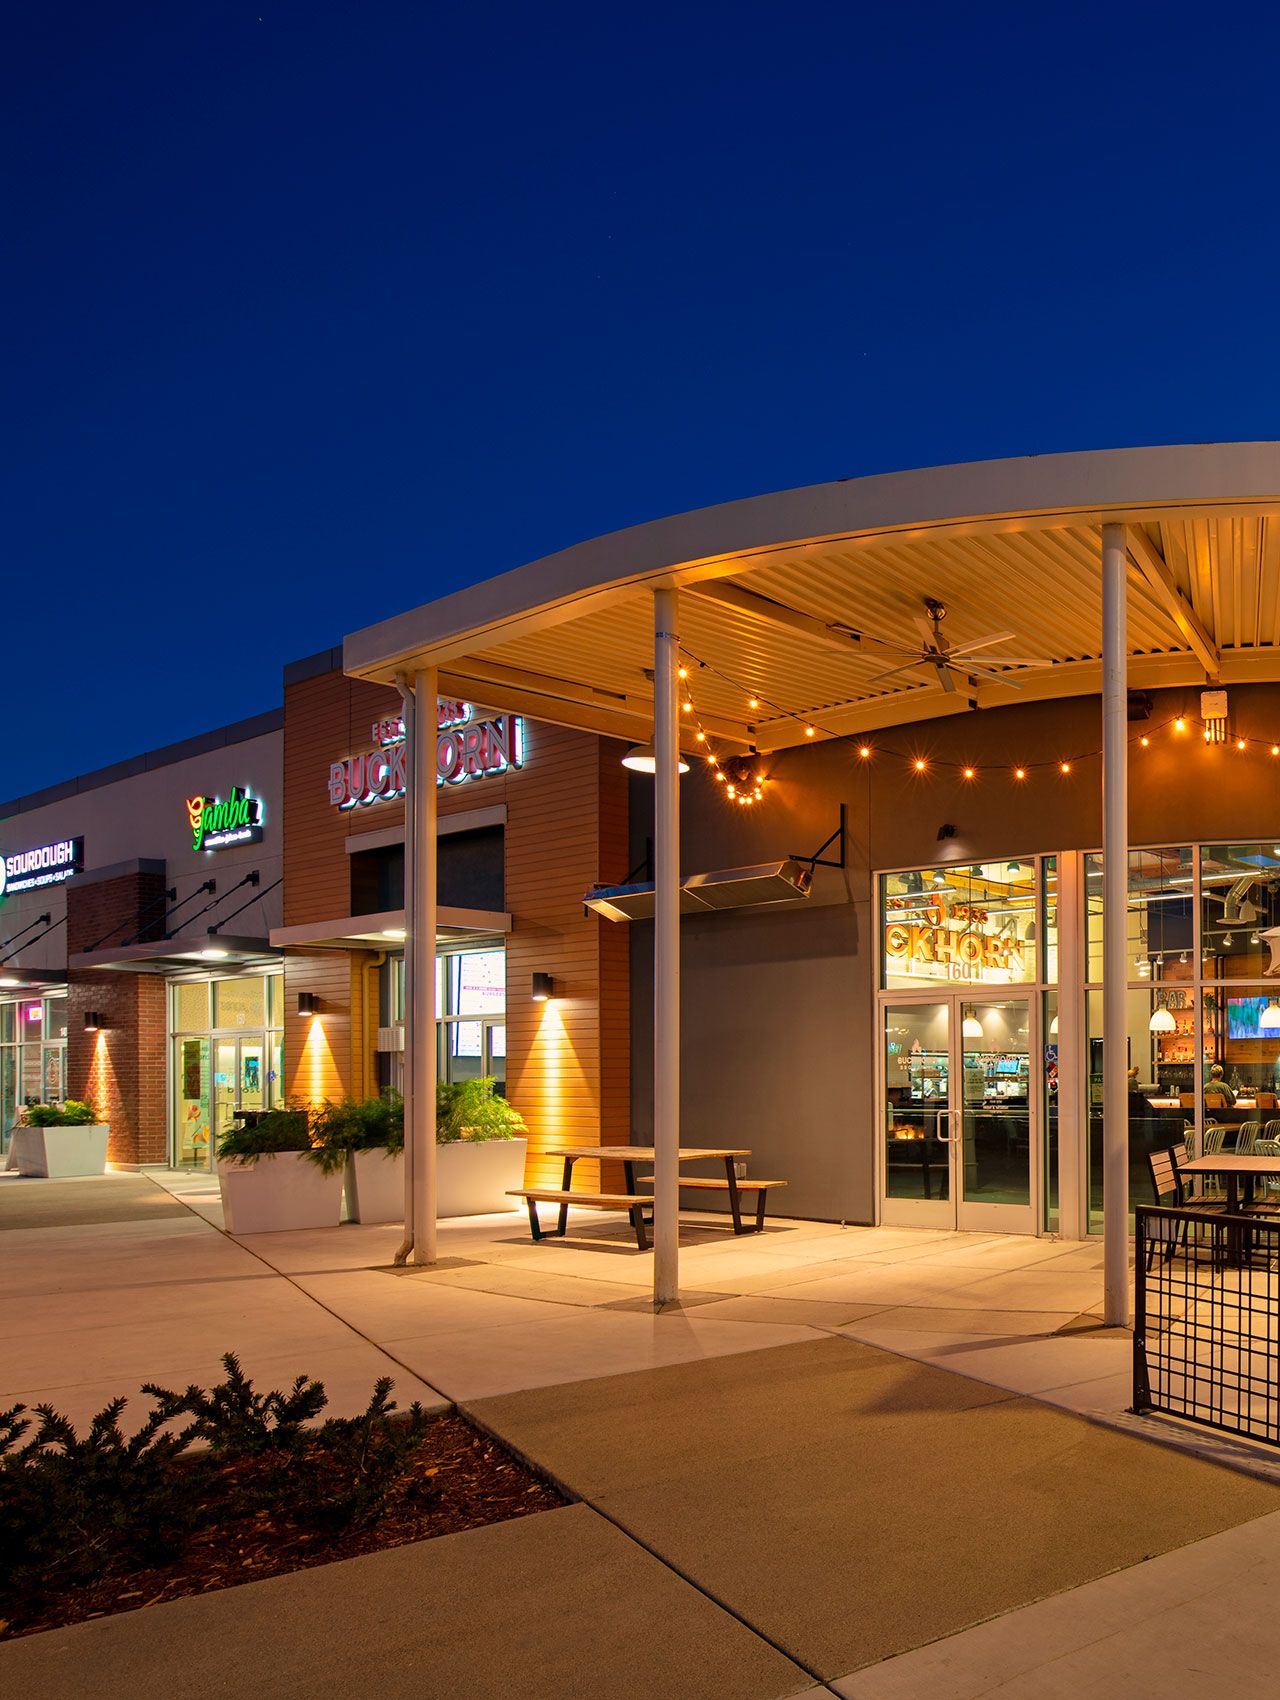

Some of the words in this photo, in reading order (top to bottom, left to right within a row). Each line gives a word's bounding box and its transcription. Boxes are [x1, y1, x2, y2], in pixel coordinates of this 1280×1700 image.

[328, 714, 516, 804] BUCKORN
[6, 840, 73, 877] SOURDOUGH
[886, 923, 1026, 971] CKHORN
